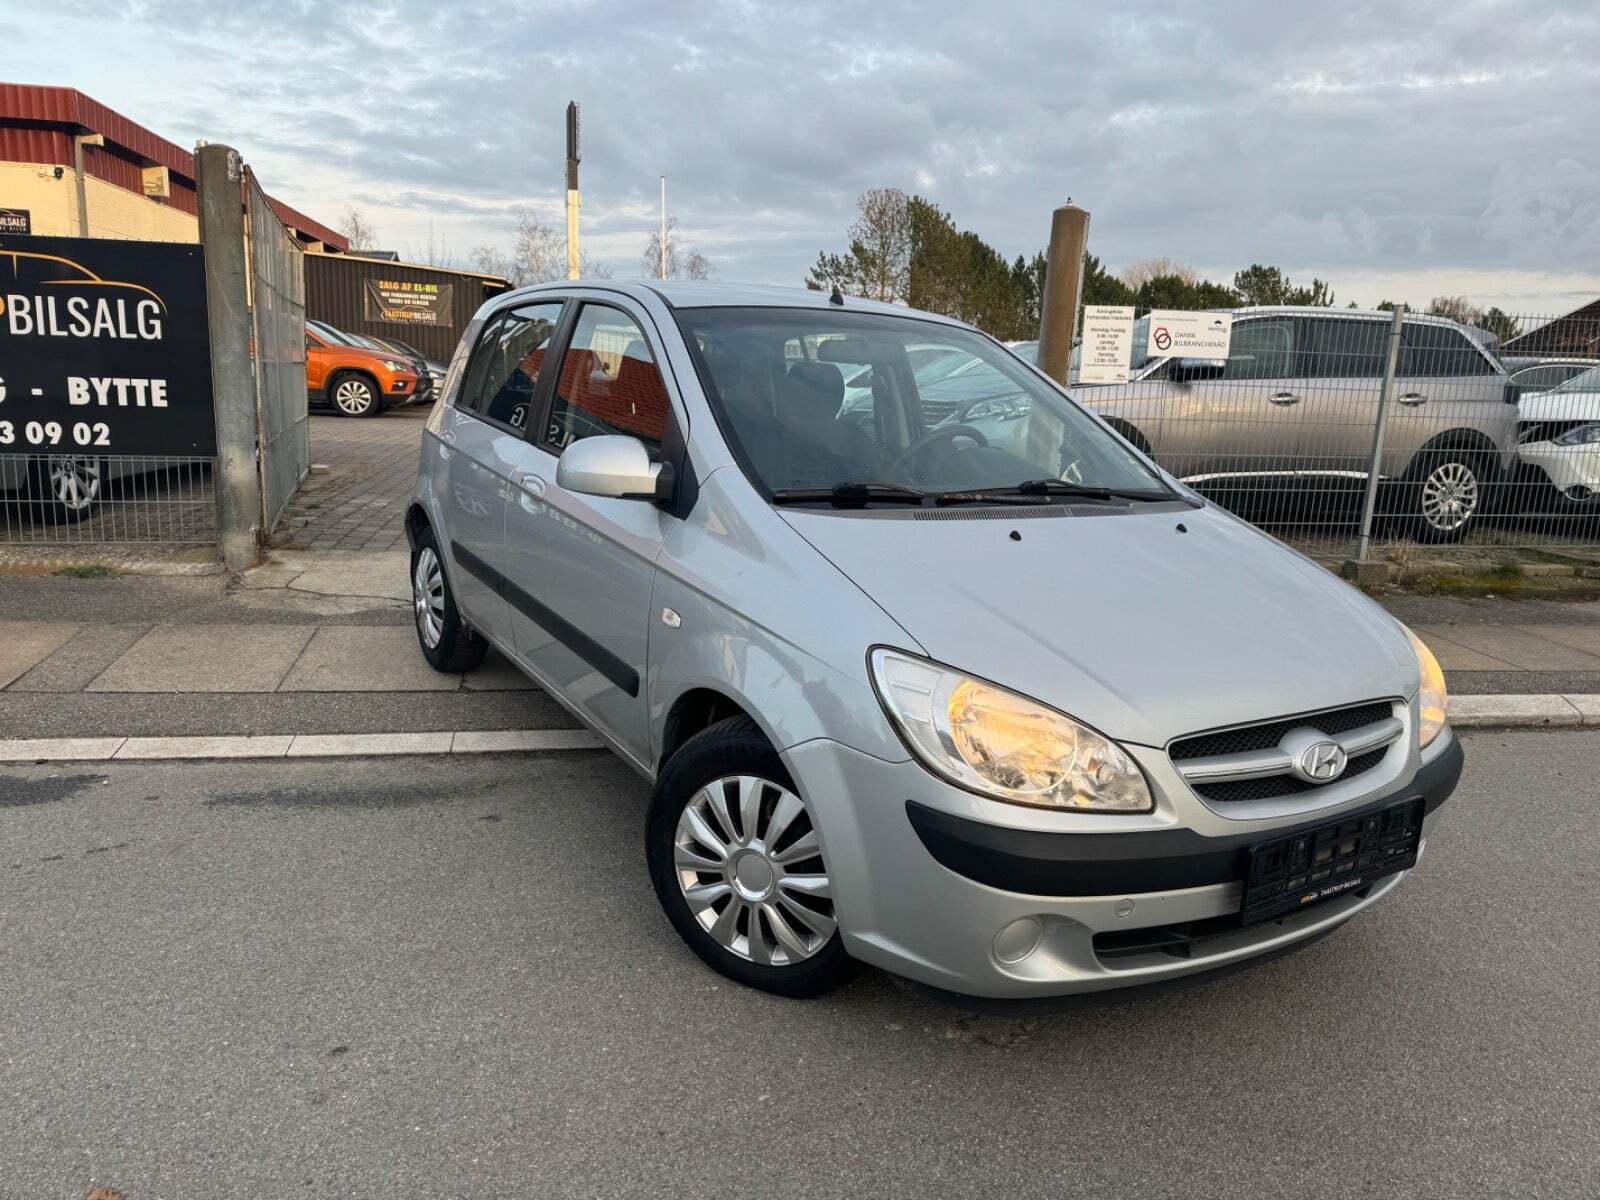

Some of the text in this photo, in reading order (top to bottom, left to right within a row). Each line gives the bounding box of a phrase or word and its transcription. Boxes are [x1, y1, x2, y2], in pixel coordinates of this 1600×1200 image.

[379, 280, 399, 289] SALG
[67, 377, 168, 408] BYTTE
[25, 421, 62, 445] 09
[73, 422, 111, 446] 02
